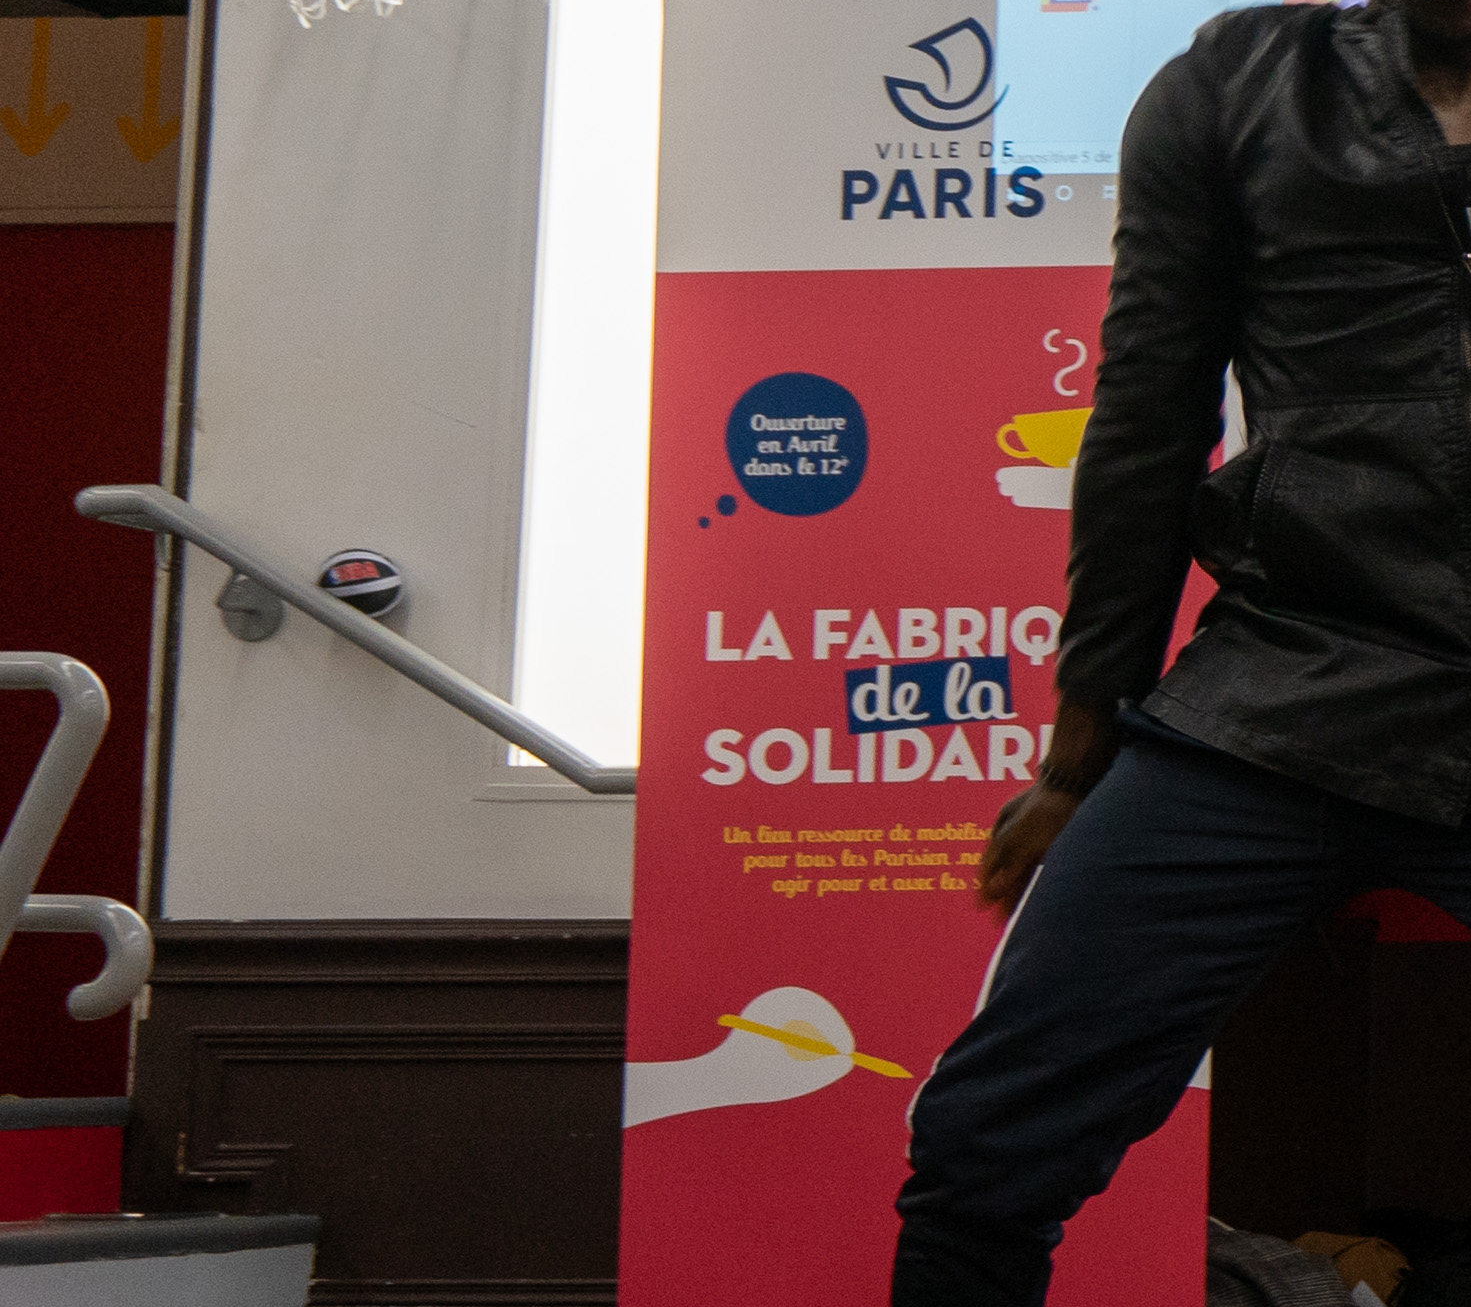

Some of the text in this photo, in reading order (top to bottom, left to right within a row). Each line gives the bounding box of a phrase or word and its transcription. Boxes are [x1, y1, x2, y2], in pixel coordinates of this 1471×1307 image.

[875, 140, 1015, 160] VILLE DE
[840, 165, 1046, 220] PARIS
[750, 413, 847, 432] Ouverture
[757, 434, 840, 454] en Avril
[743, 457, 793, 476] dans
[797, 456, 817, 475] le
[705, 609, 794, 662] LA
[851, 661, 1019, 722] de la
[723, 826, 753, 844] Un
[757, 825, 793, 843] lieu
[797, 828, 884, 843] ressource
[889, 822, 914, 842] de
[743, 848, 869, 874] pour tous les
[771, 875, 813, 899] agir
[816, 878, 864, 898] pour
[868, 874, 891, 892] et
[892, 877, 937, 892] avec
[939, 871, 967, 891] les
